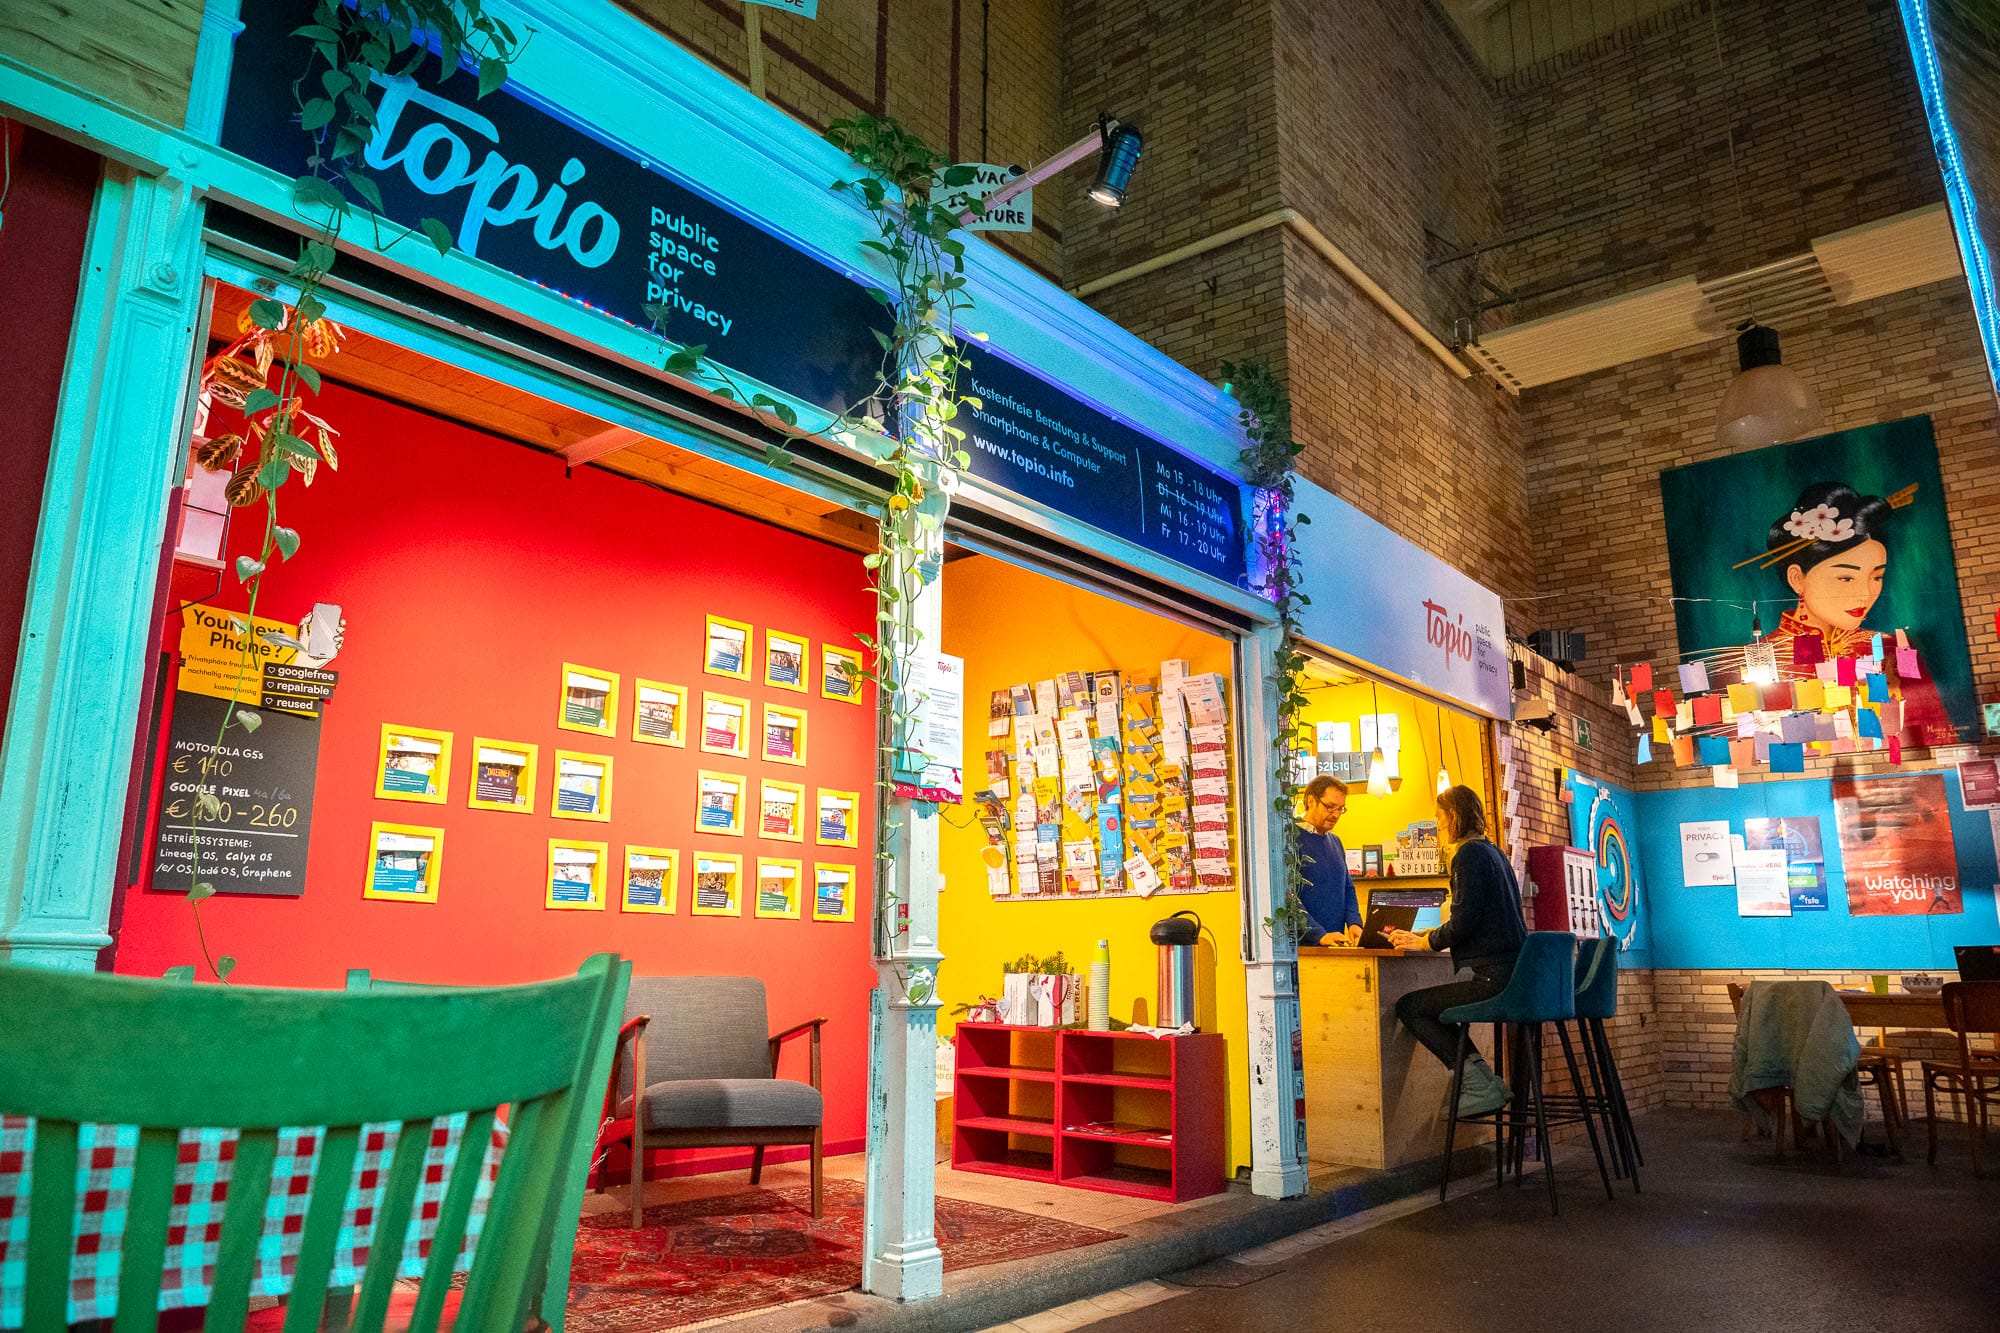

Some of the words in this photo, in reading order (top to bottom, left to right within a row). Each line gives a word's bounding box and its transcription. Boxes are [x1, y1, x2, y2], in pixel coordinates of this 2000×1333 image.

[651, 206, 719, 252] public
[648, 231, 716, 276] space
[648, 252, 684, 283] for
[647, 281, 732, 336] privacy
[971, 378, 1033, 419] Kostenfreie
[1035, 409, 1080, 444] Beratung
[1082, 433, 1090, 447] &
[1091, 437, 1127, 466] Support
[972, 406, 1039, 446] Smartphone
[1042, 436, 1050, 451] &
[1052, 441, 1101, 473] Computer
[973, 435, 1075, 488] www.topio.info
[1156, 461, 1171, 479] Mo
[1173, 469, 1184, 485] 15
[1193, 480, 1204, 496] 18
[1206, 487, 1222, 504] Uhr
[1160, 503, 1172, 519] Mi
[1178, 511, 1188, 527] 16
[1197, 519, 1207, 536] 19
[1209, 527, 1225, 544] Uhr
[1161, 523, 1171, 539] Fr
[1178, 530, 1189, 546] 17
[1198, 539, 1209, 555] 20
[1210, 544, 1226, 563] Uhr
[1475, 623, 1491, 638] public
[209, 631, 283, 658] Phone?
[277, 667, 335, 681] googlefree
[1478, 660, 1498, 677] privacy
[276, 682, 330, 695] repairable
[276, 699, 314, 710] reused
[175, 741, 240, 757] MOTOROLA
[171, 754, 192, 774] €
[222, 786, 251, 798] PIXEL
[164, 799, 190, 819] €
[249, 803, 298, 828] 260
[225, 852, 256, 864] Calyx
[259, 852, 273, 862] OS
[1402, 851, 1414, 860] THX
[241, 866, 292, 882] Graphene
[1864, 873, 1956, 890] Watching
[1889, 887, 1927, 904] you
